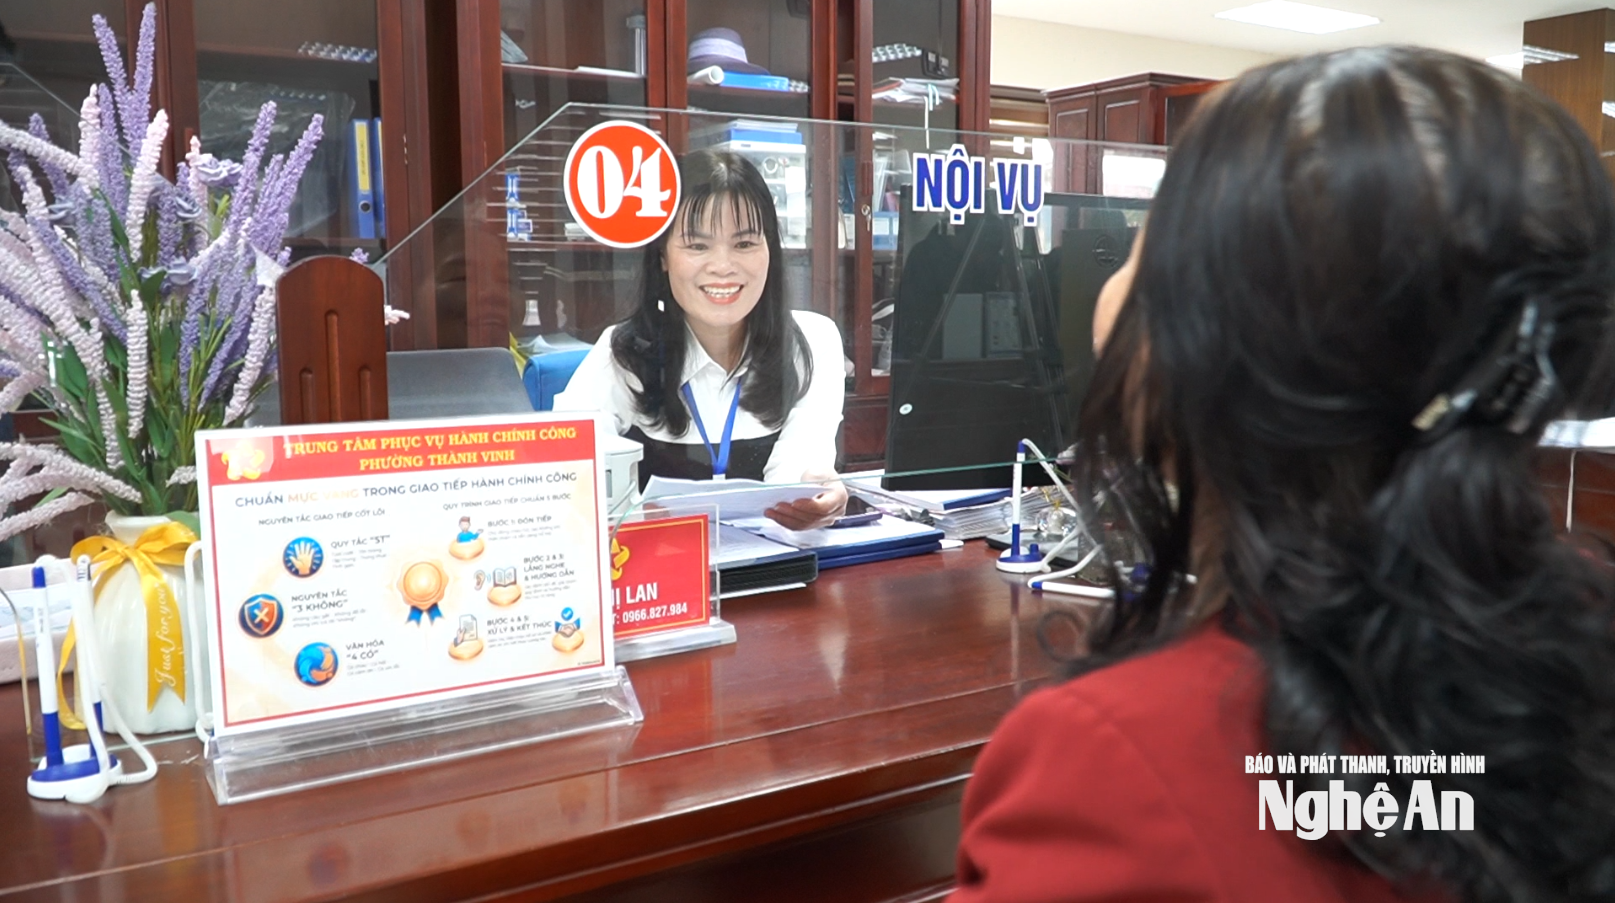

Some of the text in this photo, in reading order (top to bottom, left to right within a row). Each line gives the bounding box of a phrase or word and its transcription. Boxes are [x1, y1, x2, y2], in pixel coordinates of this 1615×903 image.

[577, 145, 671, 219] 04
[914, 145, 1043, 226] NỘI VỤ
[284, 426, 577, 456] TRUNG TÂM PHỤC VỤ HÀNH CHÍNH CÔNG
[359, 450, 515, 470] PHƯỜNG THÀNH VINH
[235, 491, 283, 507] CHUẨN
[363, 485, 406, 498] TRONG
[409, 483, 439, 494] GIAO
[442, 477, 468, 492] TIẾP
[471, 477, 504, 489] HÀNH
[507, 474, 543, 486] CHÍNH
[546, 472, 577, 483] CÔNG
[443, 503, 458, 511] QUY
[258, 516, 293, 526] NGUYÊN
[313, 513, 334, 522] GIAO
[330, 540, 349, 550] QUY
[625, 582, 658, 604] LAN
[622, 602, 688, 624] 0966.827.984
